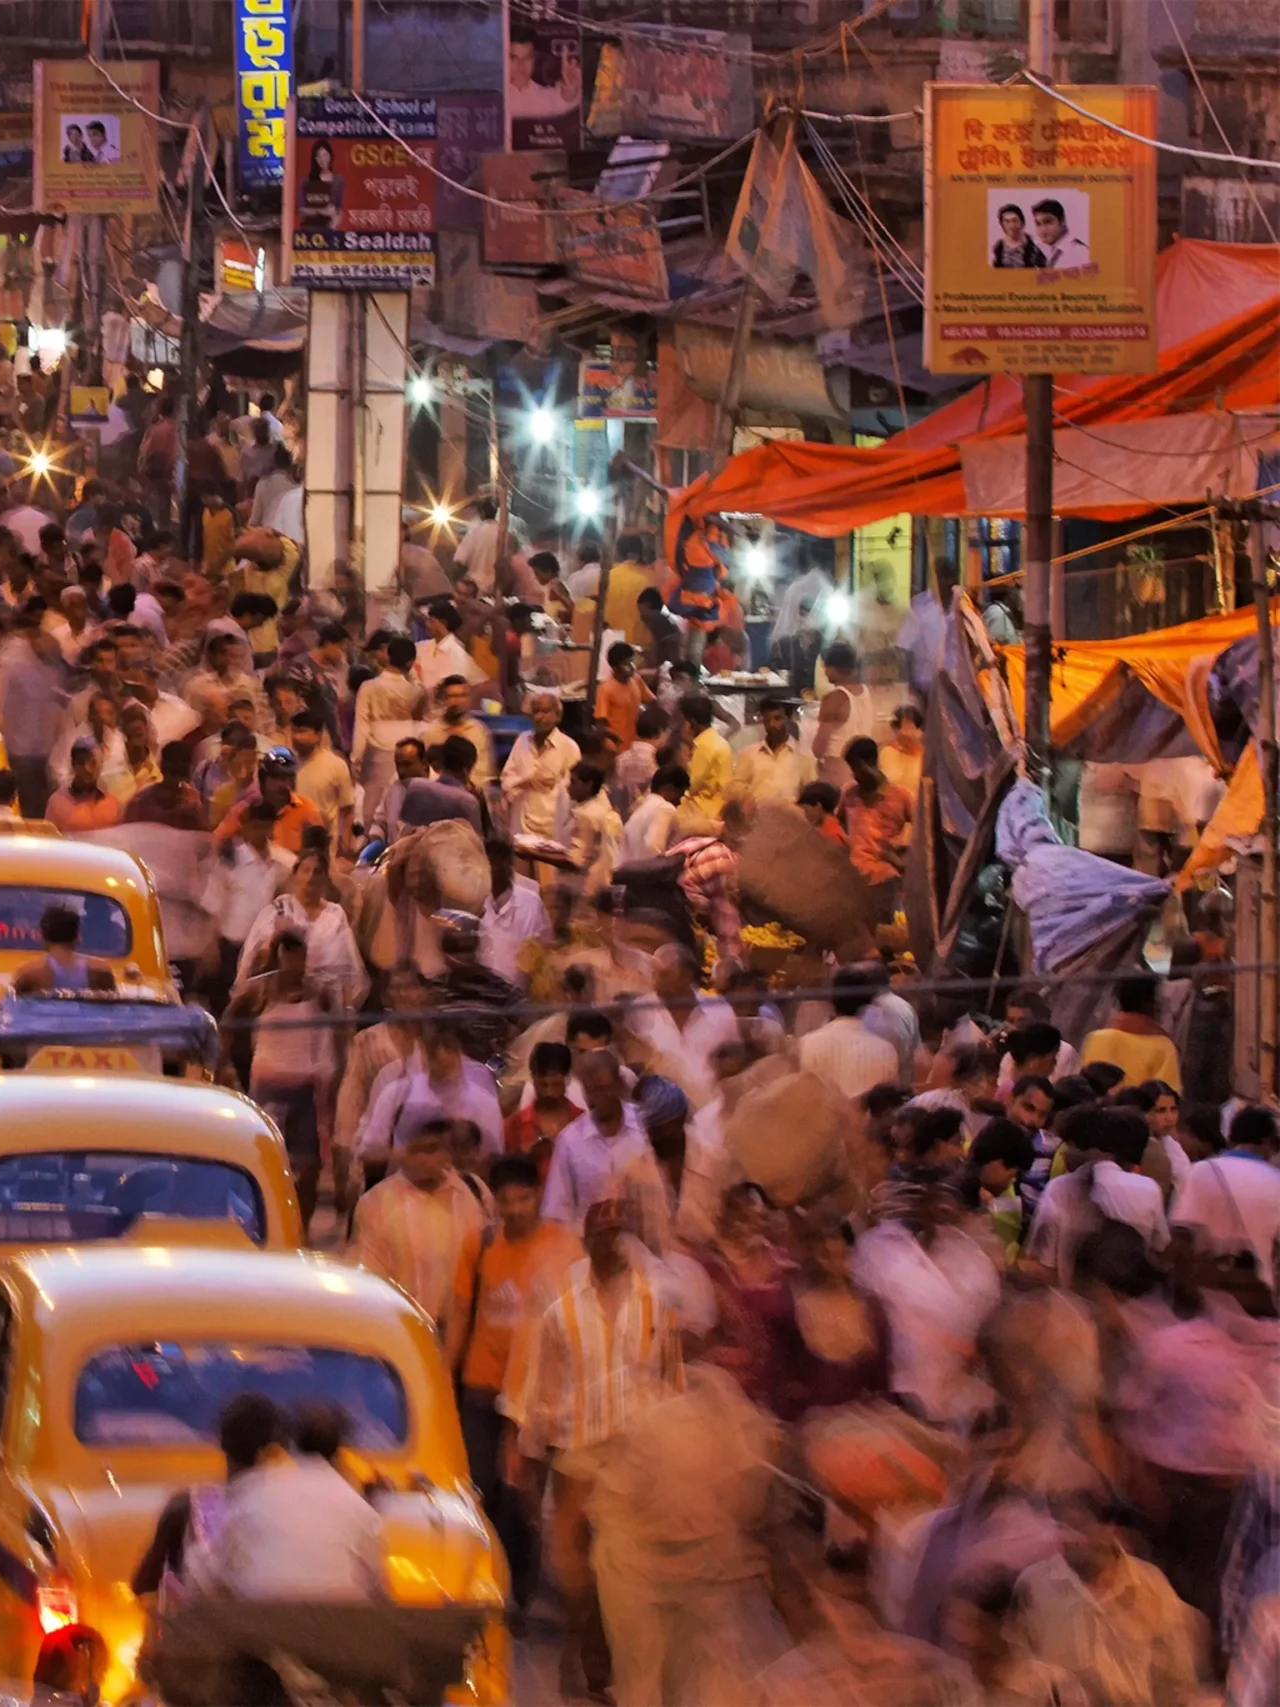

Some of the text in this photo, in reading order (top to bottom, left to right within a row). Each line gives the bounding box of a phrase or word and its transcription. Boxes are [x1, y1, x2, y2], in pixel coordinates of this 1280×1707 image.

[324, 96, 436, 116] George School of
[297, 118, 436, 138] Competitive Exams
[344, 231, 431, 249] Sealdah
[45, 1050, 127, 1069] TAXI
